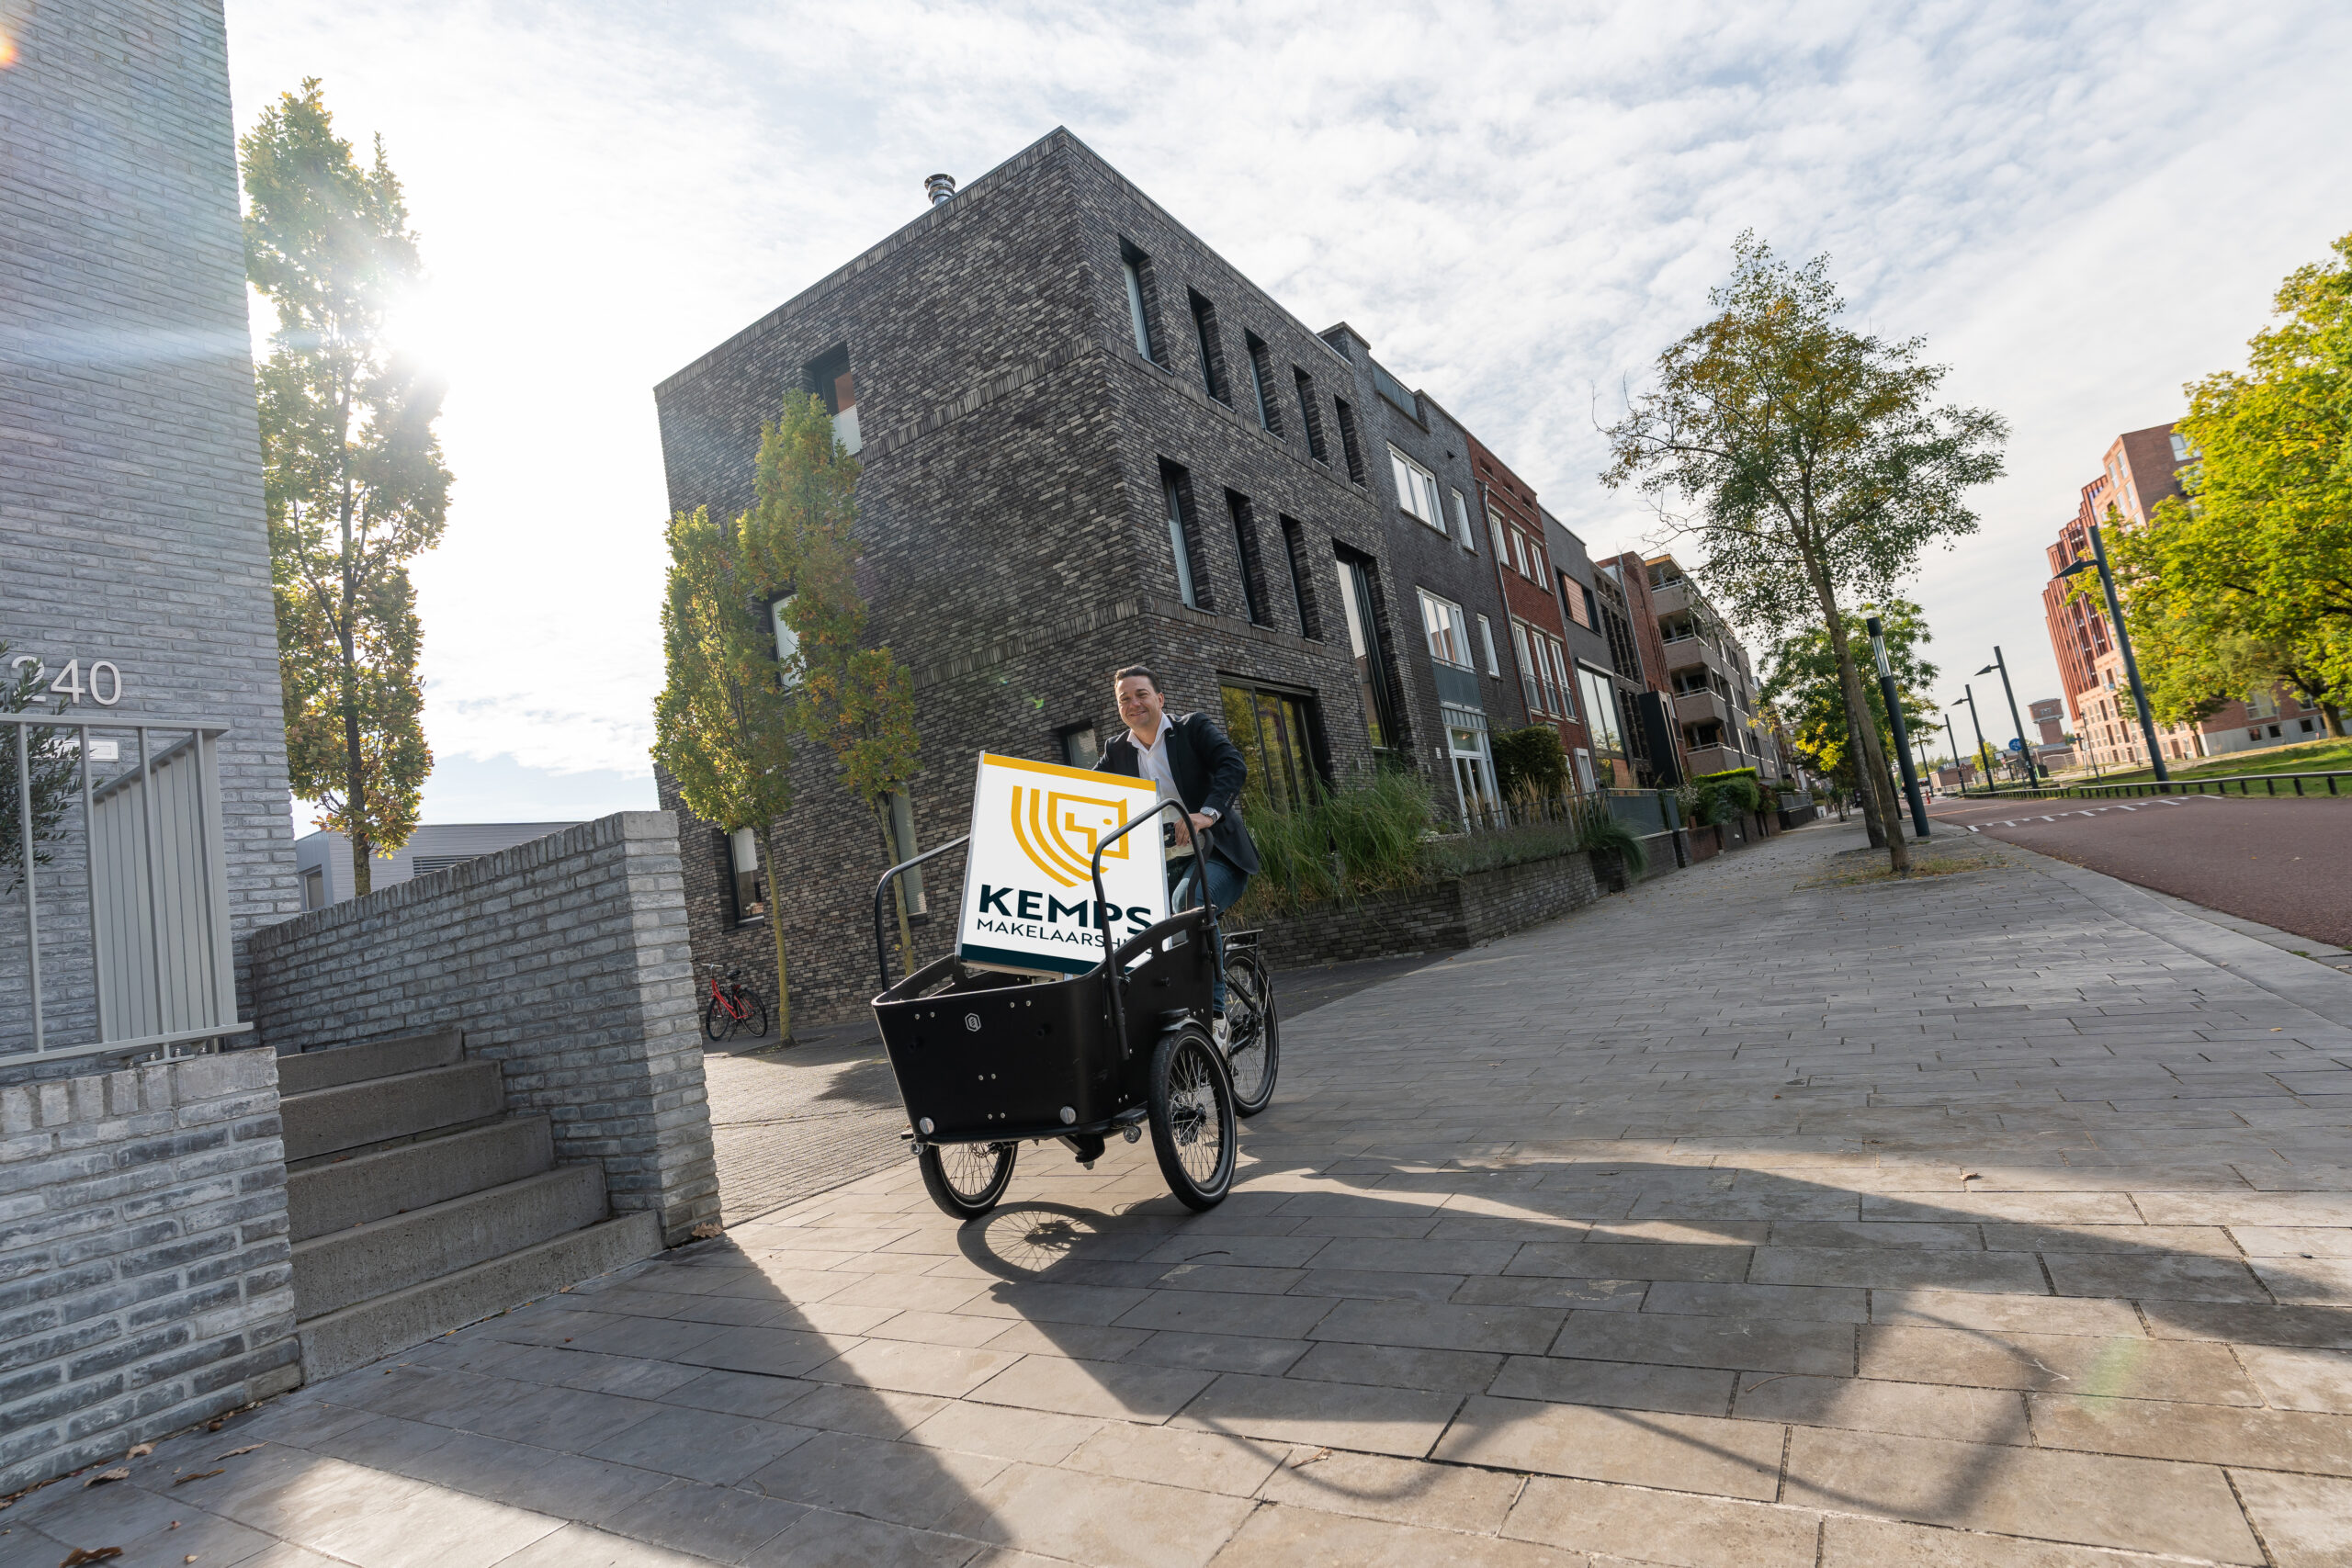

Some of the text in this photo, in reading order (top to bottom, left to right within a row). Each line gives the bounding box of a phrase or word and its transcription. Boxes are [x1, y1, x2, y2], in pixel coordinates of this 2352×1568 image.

[11, 655, 122, 705] 240
[978, 884, 1153, 935] KEMPS
[977, 918, 1153, 955] MAKELAARSH
